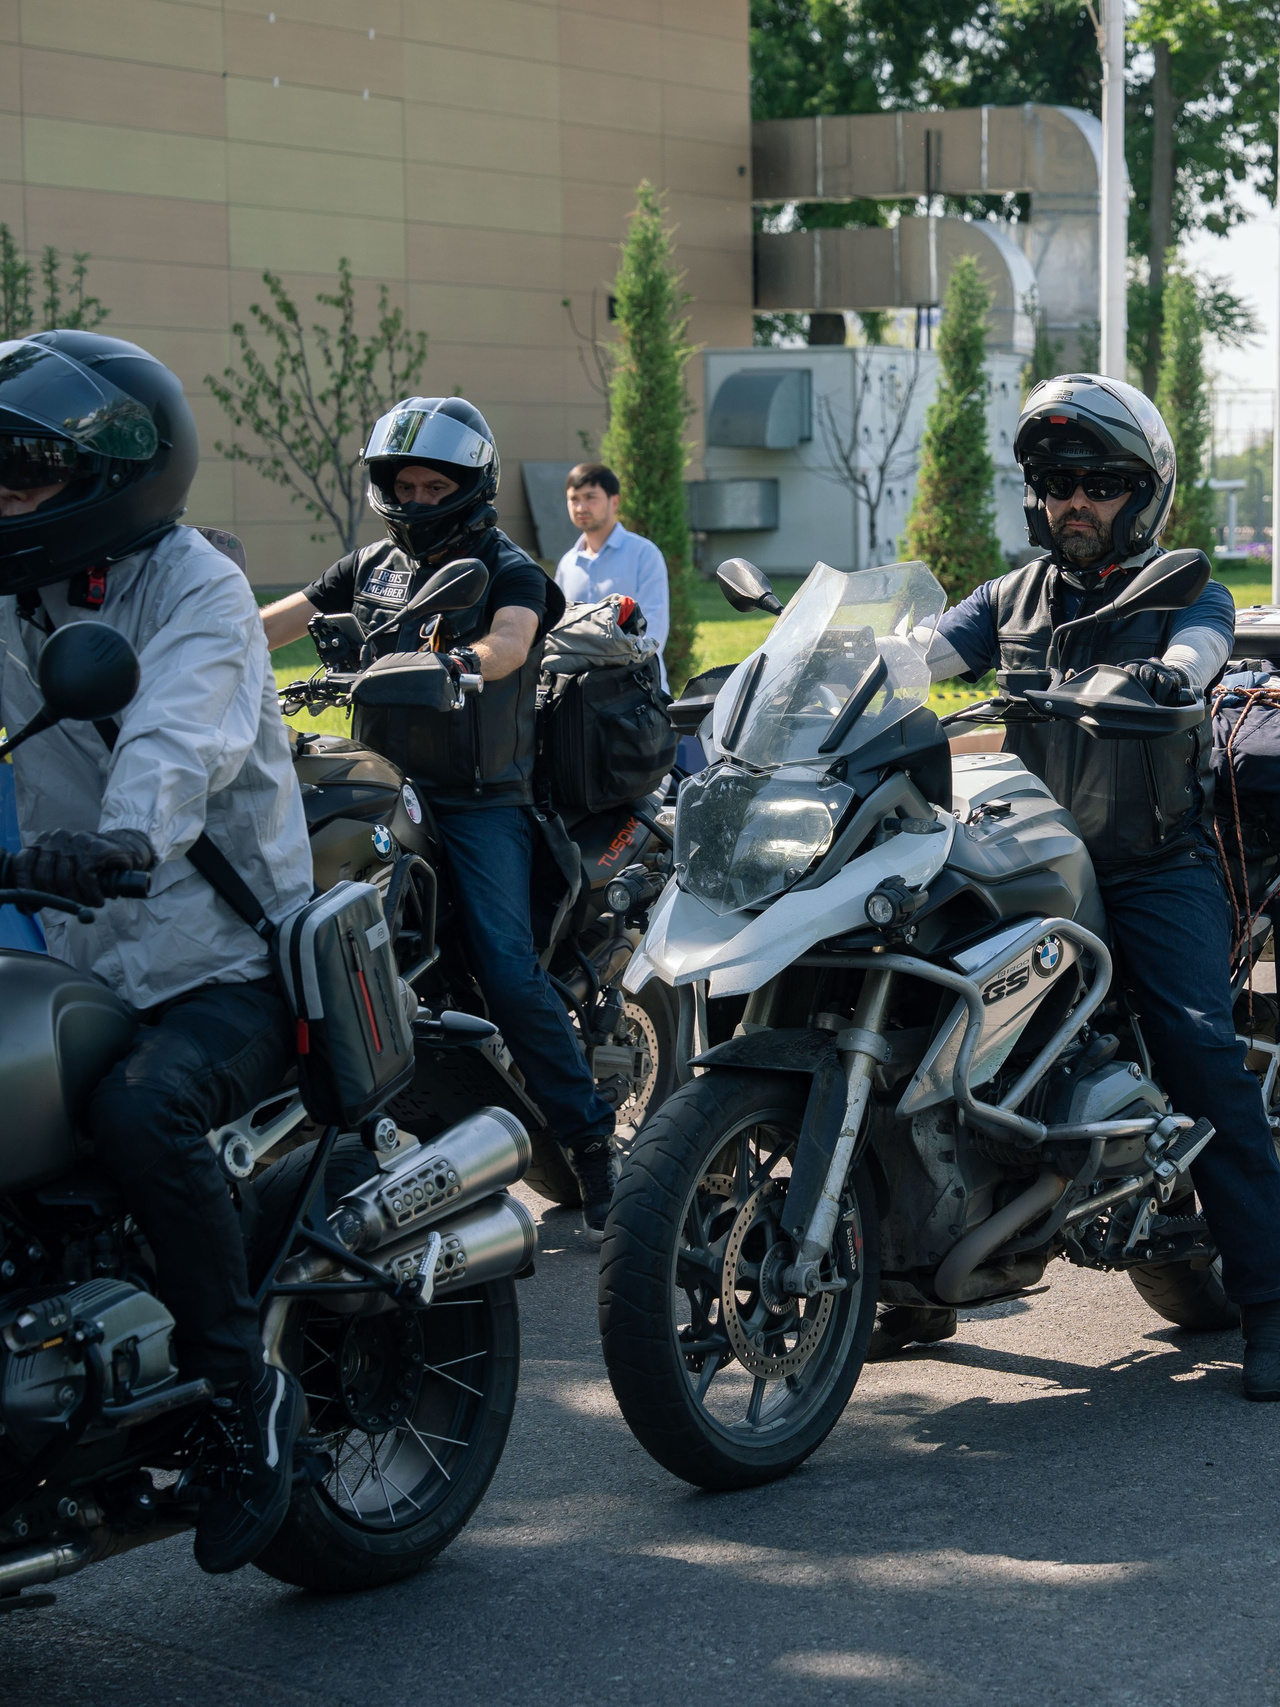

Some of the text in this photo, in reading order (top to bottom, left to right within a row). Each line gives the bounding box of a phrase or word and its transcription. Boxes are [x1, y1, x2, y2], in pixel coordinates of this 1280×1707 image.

[1051, 447, 1095, 456] CHUBERTH
[378, 570, 403, 583] IRBIS
[367, 583, 404, 598] MEMBER
[981, 965, 1030, 1007] GS
[846, 1227, 857, 1270] brembo
